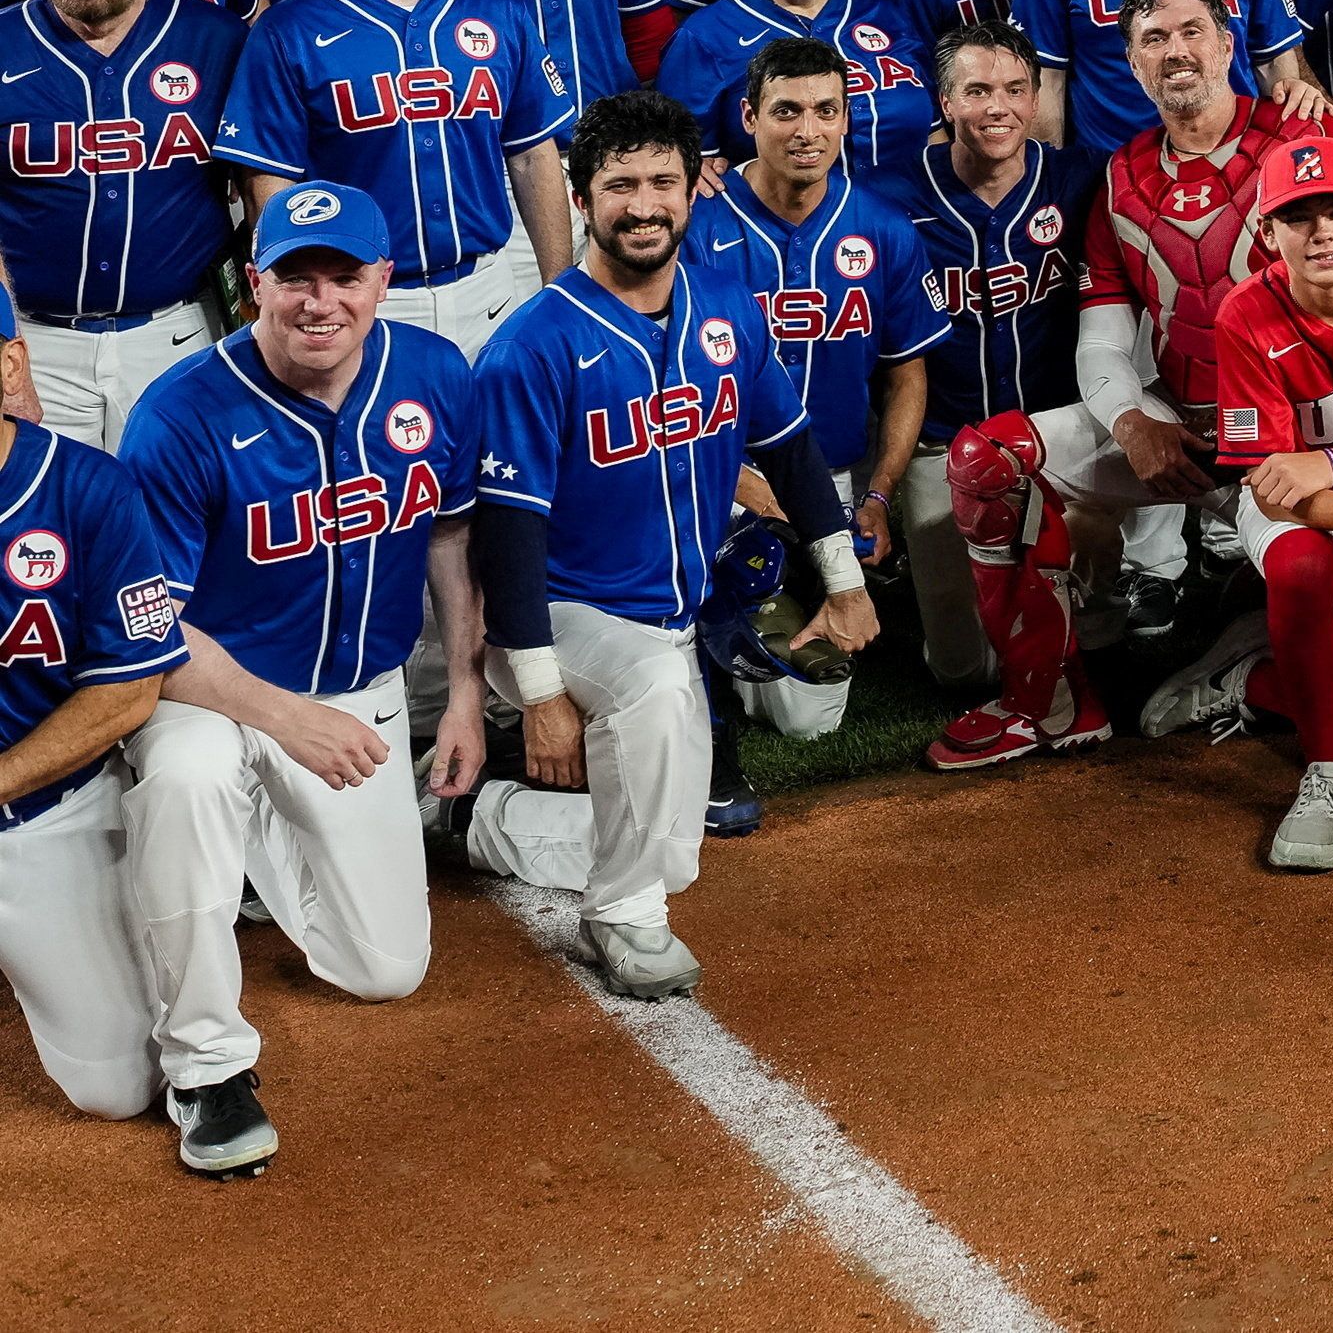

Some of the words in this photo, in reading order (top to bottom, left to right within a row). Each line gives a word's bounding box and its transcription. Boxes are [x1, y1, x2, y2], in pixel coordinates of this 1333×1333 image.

[331, 66, 503, 134] USA
[8, 111, 213, 179] USA
[586, 373, 740, 469] USA
[246, 459, 442, 565] USA
[126, 579, 167, 609] USA
[129, 608, 173, 637] 250
